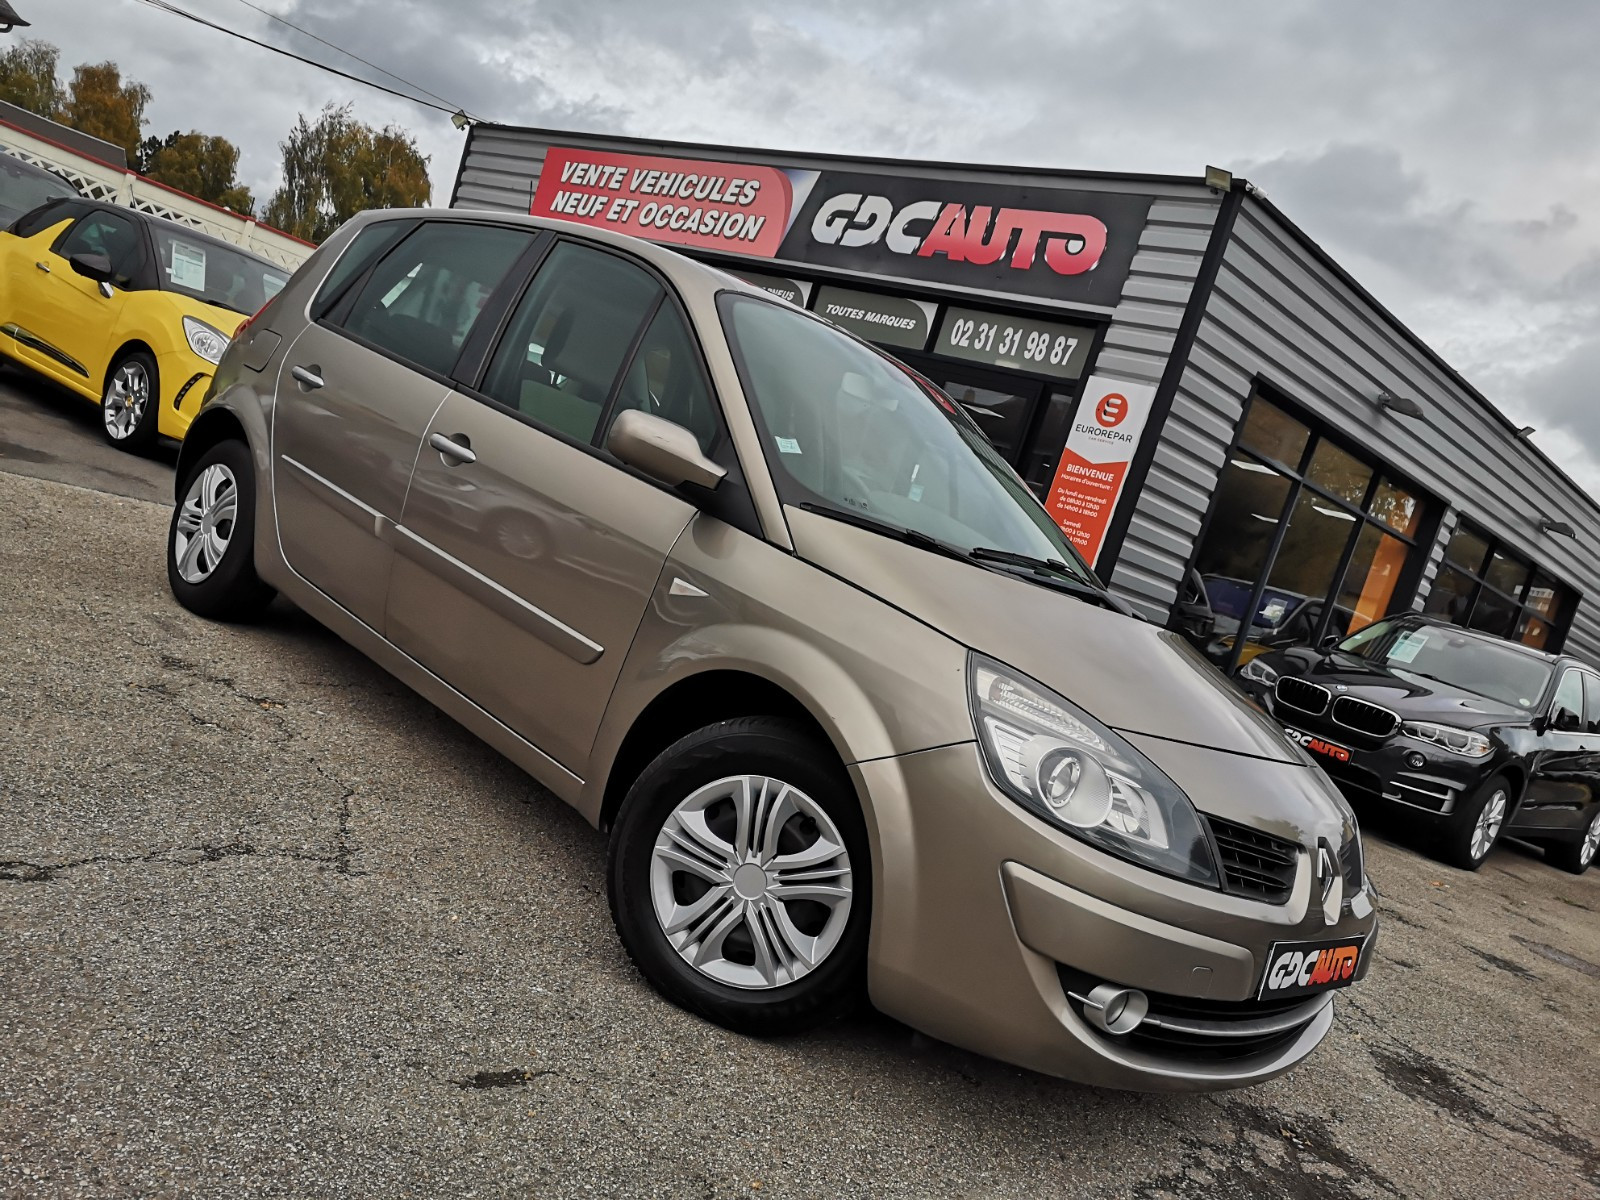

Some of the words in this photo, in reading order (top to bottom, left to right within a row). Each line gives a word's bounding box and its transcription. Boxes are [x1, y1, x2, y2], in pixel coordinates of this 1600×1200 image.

[560, 161, 628, 190] VENTE
[628, 167, 760, 206] VEHICULES
[550, 190, 608, 217] NEUF
[606, 198, 639, 223] ET
[638, 202, 766, 241] OCCASION
[825, 303, 866, 321] TOUTES
[864, 311, 917, 330] MARQUES
[950, 318, 974, 348] 02
[974, 322, 998, 352] 31
[998, 326, 1023, 356] 31
[1023, 330, 1050, 362] 98
[1050, 335, 1079, 366] 87
[1075, 424, 1133, 443] EUROREPAR
[1061, 473, 1081, 483] Horaires
[1066, 463, 1115, 482] BIENVENUE
[1065, 489, 1078, 497] lundi
